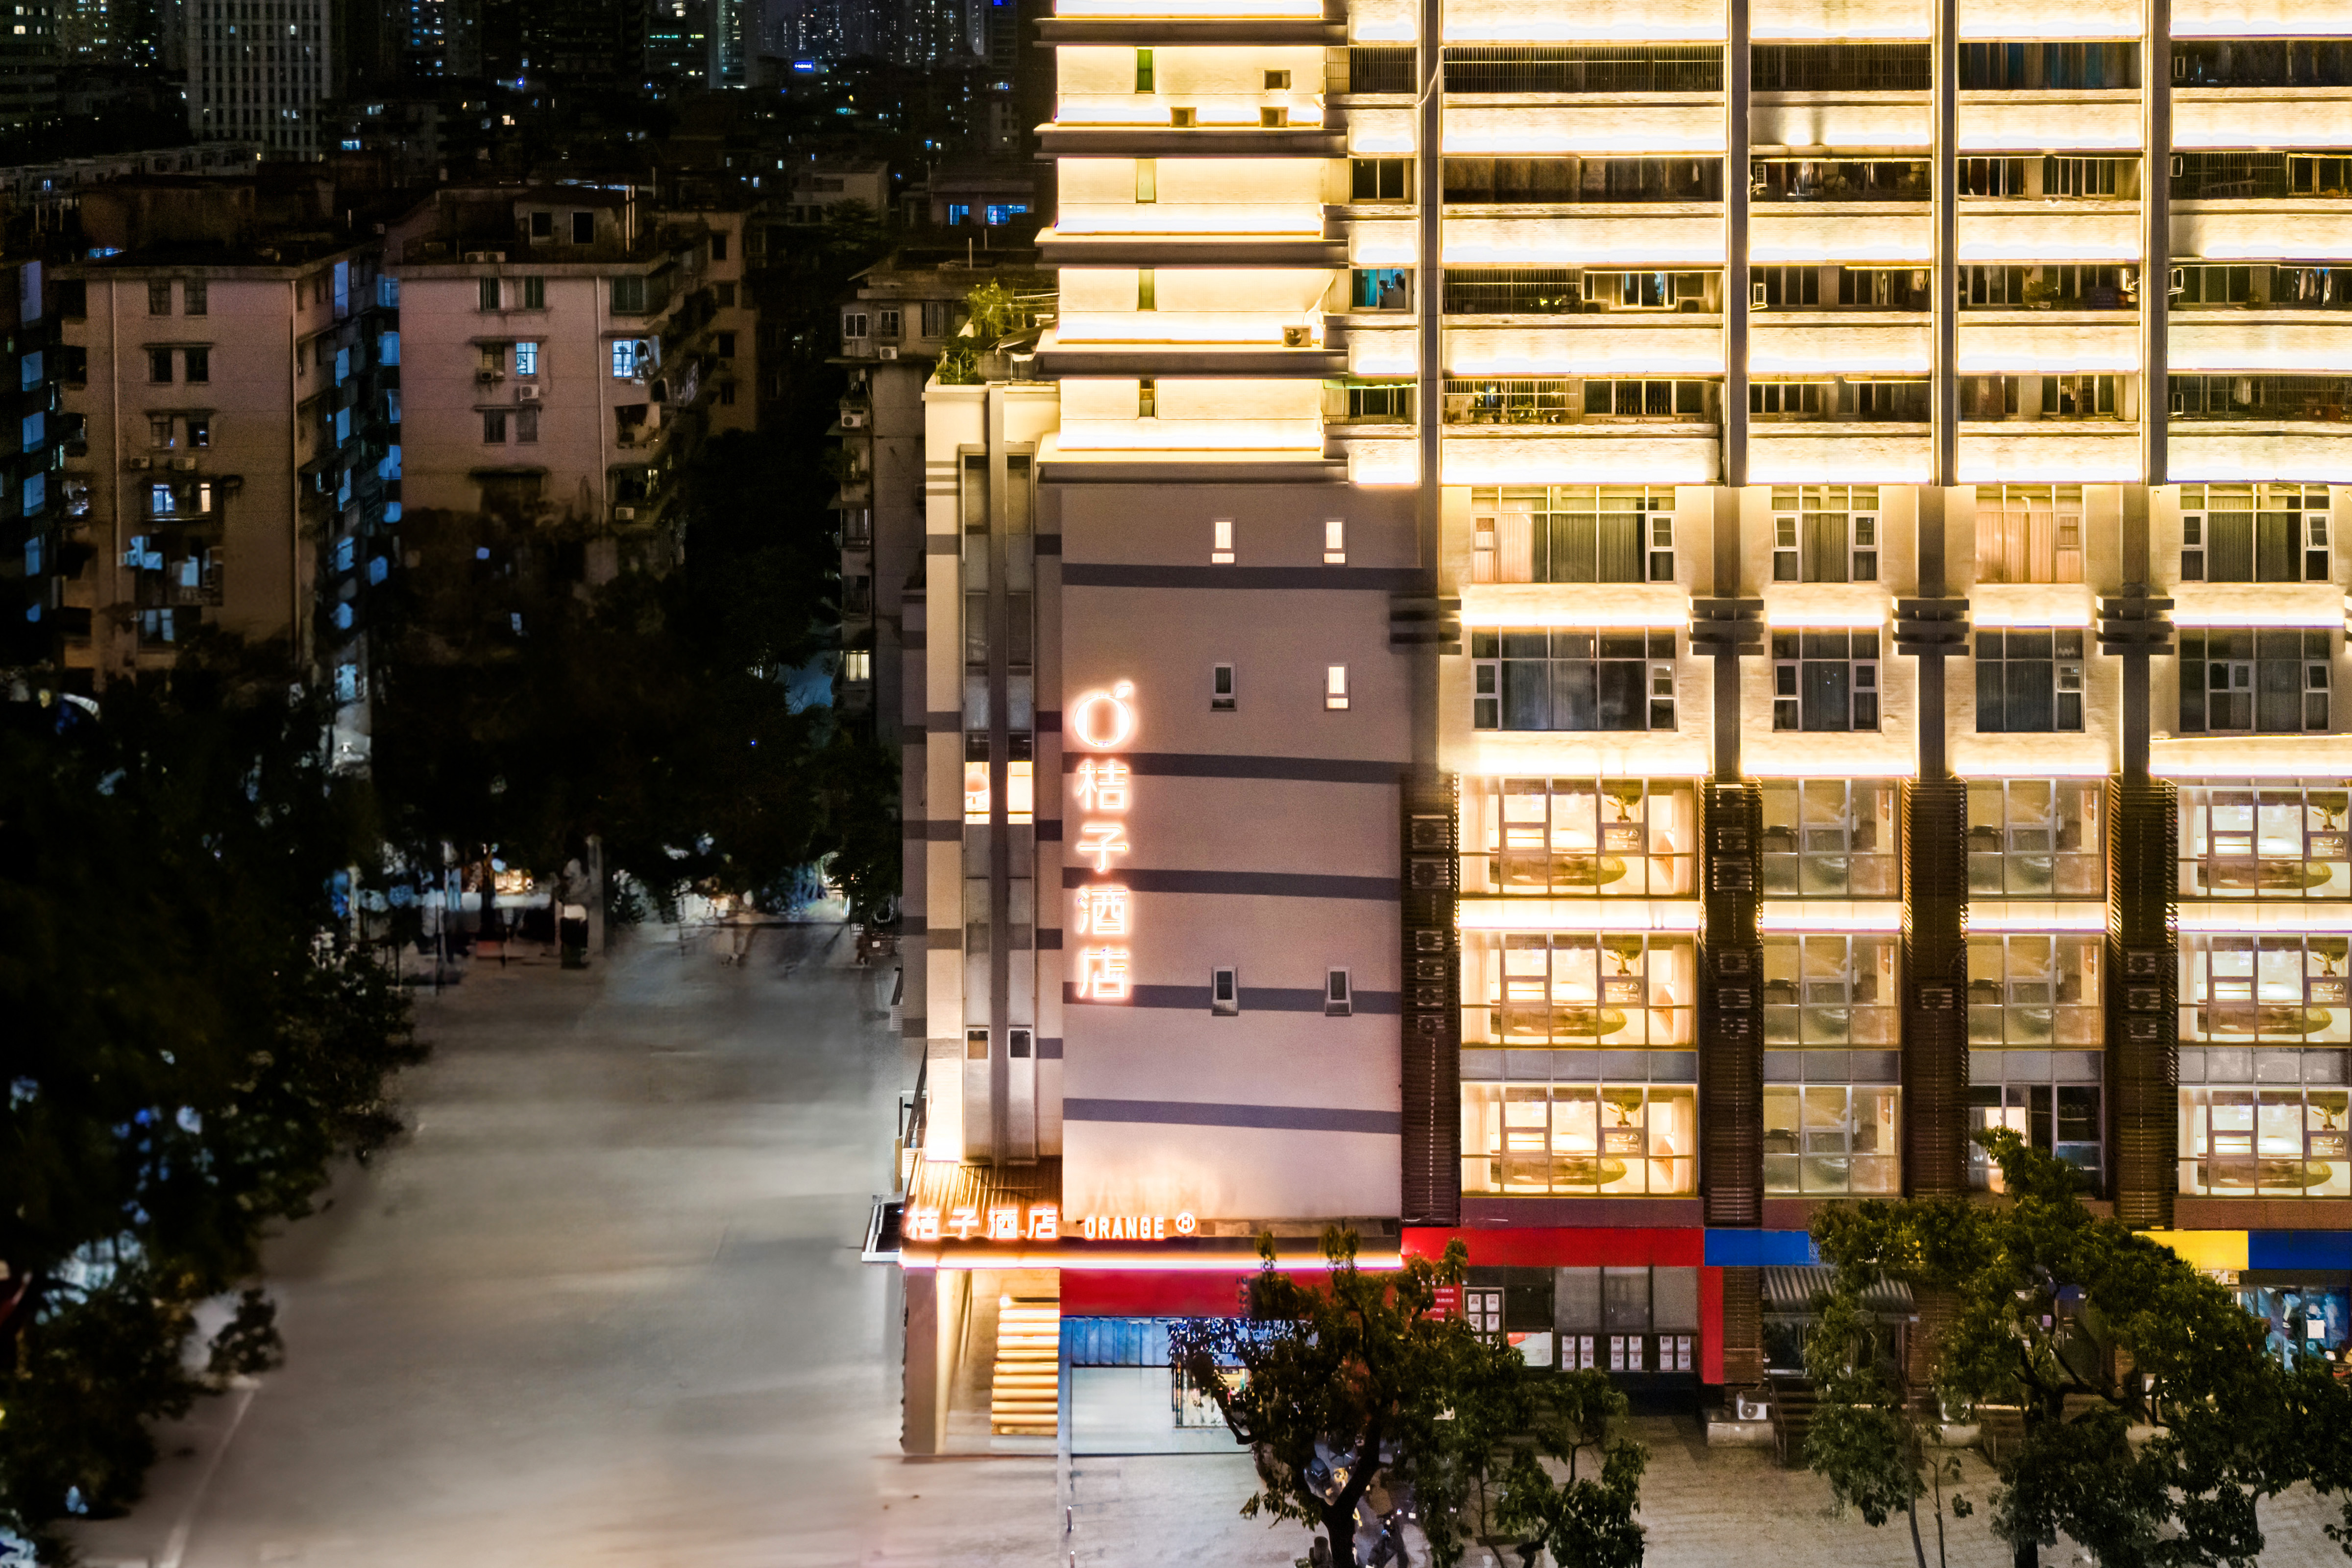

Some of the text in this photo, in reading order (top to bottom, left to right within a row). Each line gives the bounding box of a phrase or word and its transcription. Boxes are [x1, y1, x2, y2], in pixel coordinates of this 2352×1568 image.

[1078, 762, 1127, 998] 桔子酒店
[907, 1207, 1056, 1239] 桔子酒店
[1084, 1216, 1164, 1239] ORANGE
